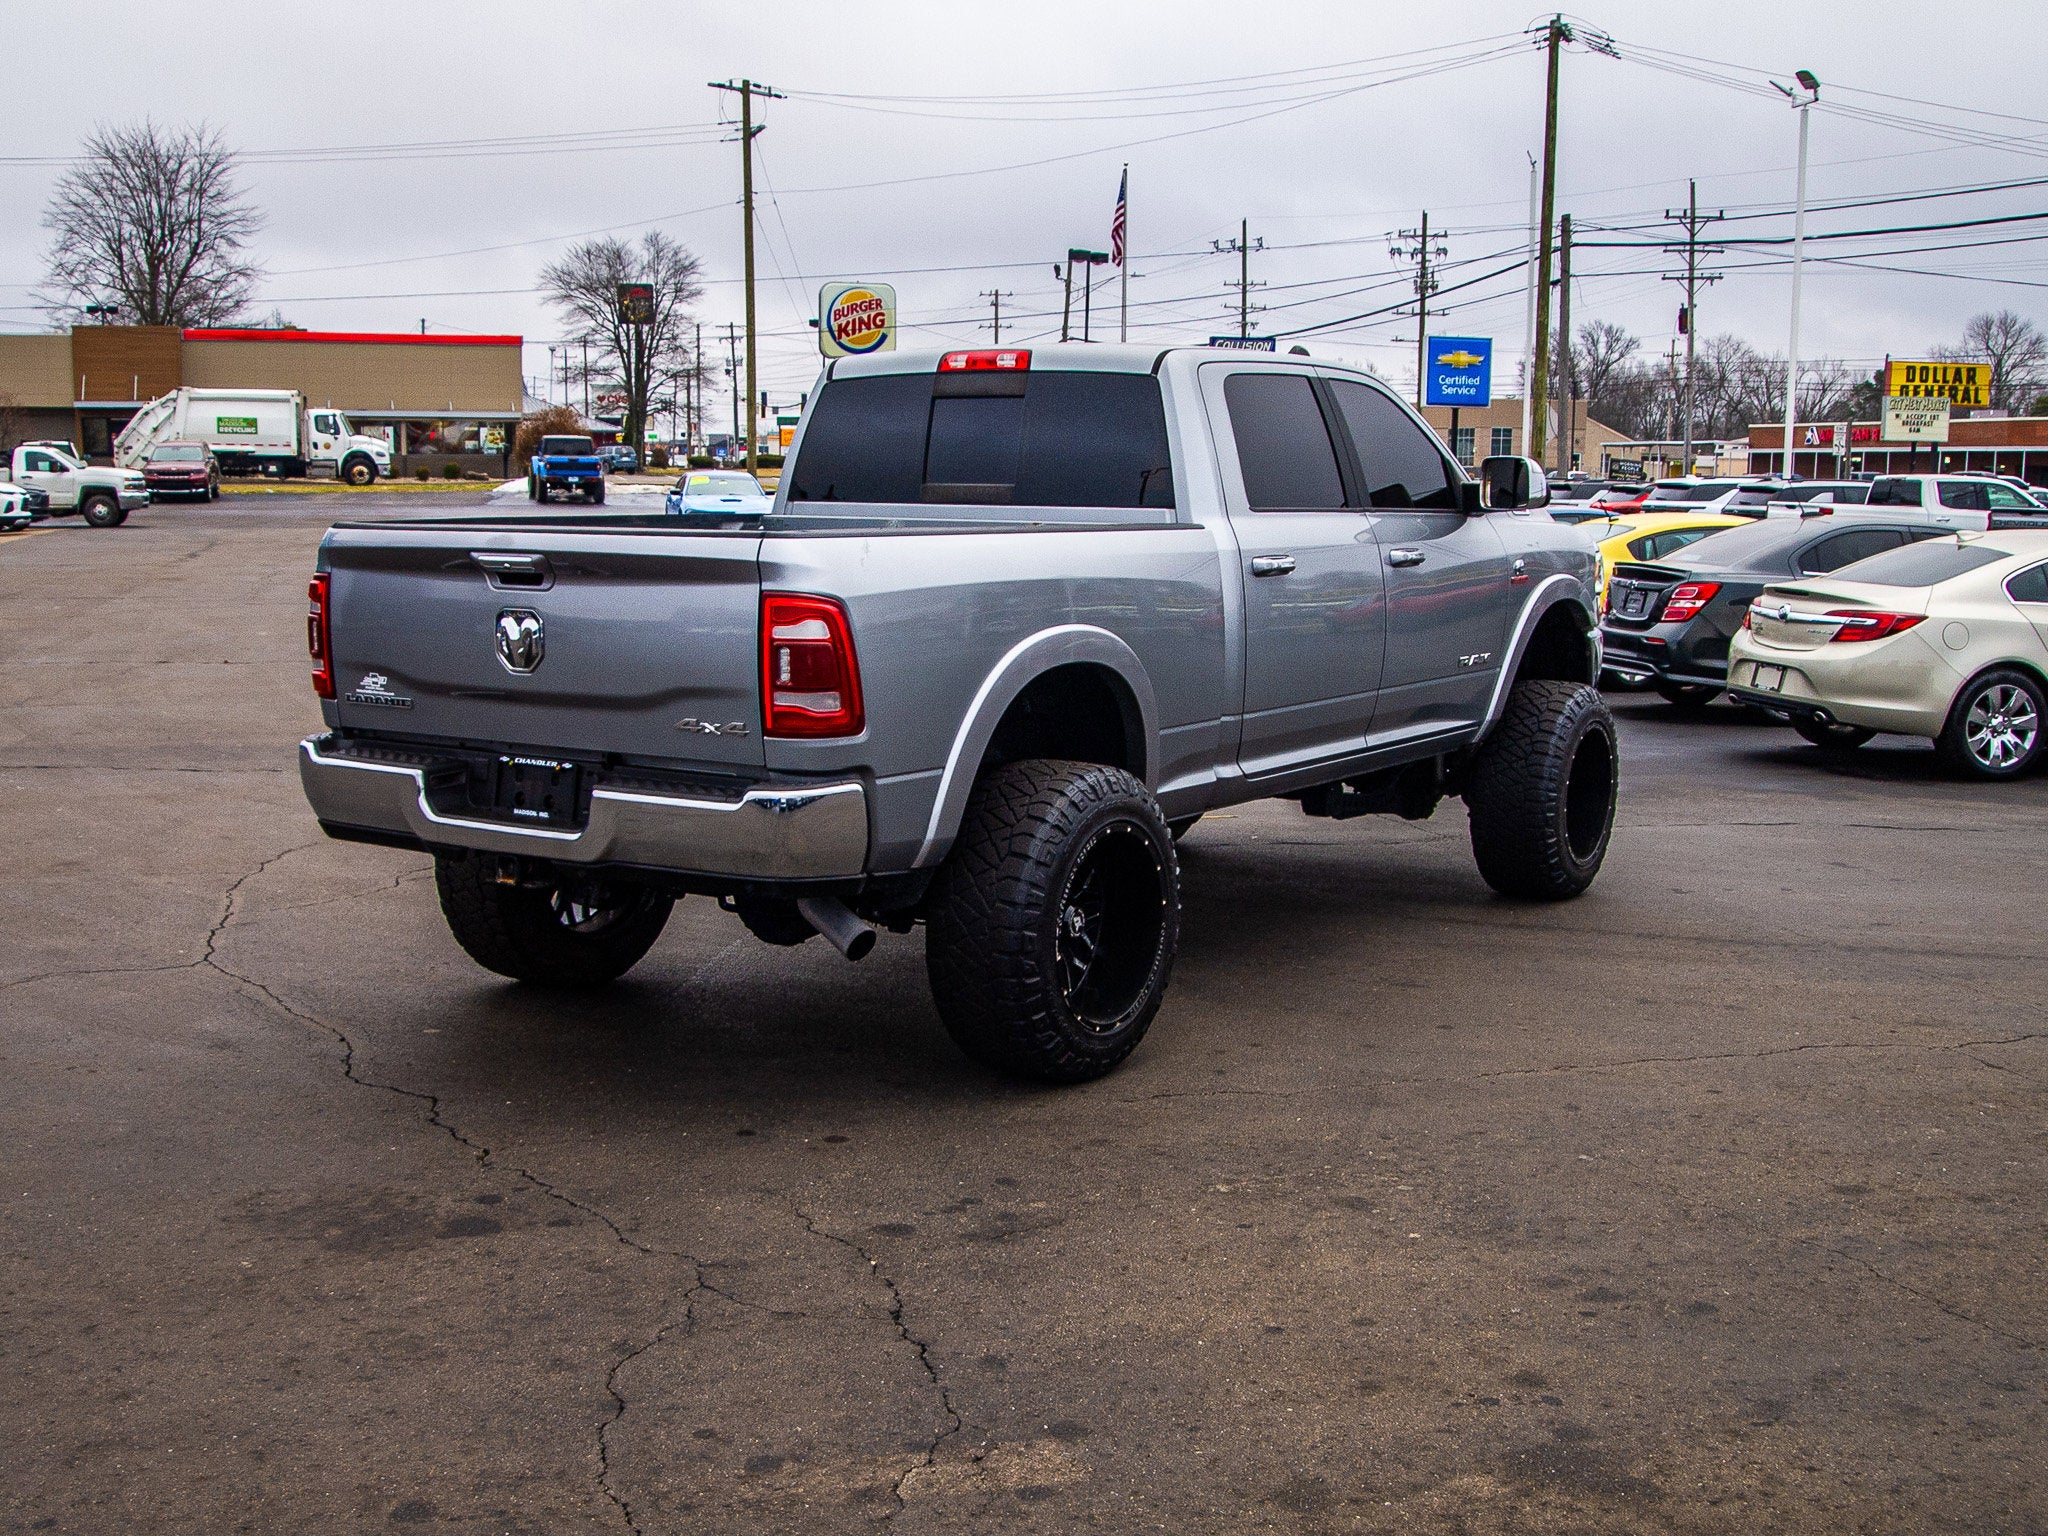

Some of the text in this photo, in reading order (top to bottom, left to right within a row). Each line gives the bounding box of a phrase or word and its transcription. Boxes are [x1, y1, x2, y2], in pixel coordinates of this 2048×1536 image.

[833, 298, 883, 322] BURGER
[837, 311, 886, 341] KING
[1215, 340, 1272, 352] COLLISION
[1438, 374, 1480, 385] Certified
[1906, 365, 1978, 384] DOLLAR
[1441, 385, 1477, 395] Service
[1922, 399, 1950, 412] MARKET
[514, 757, 558, 767] CHANDLER
